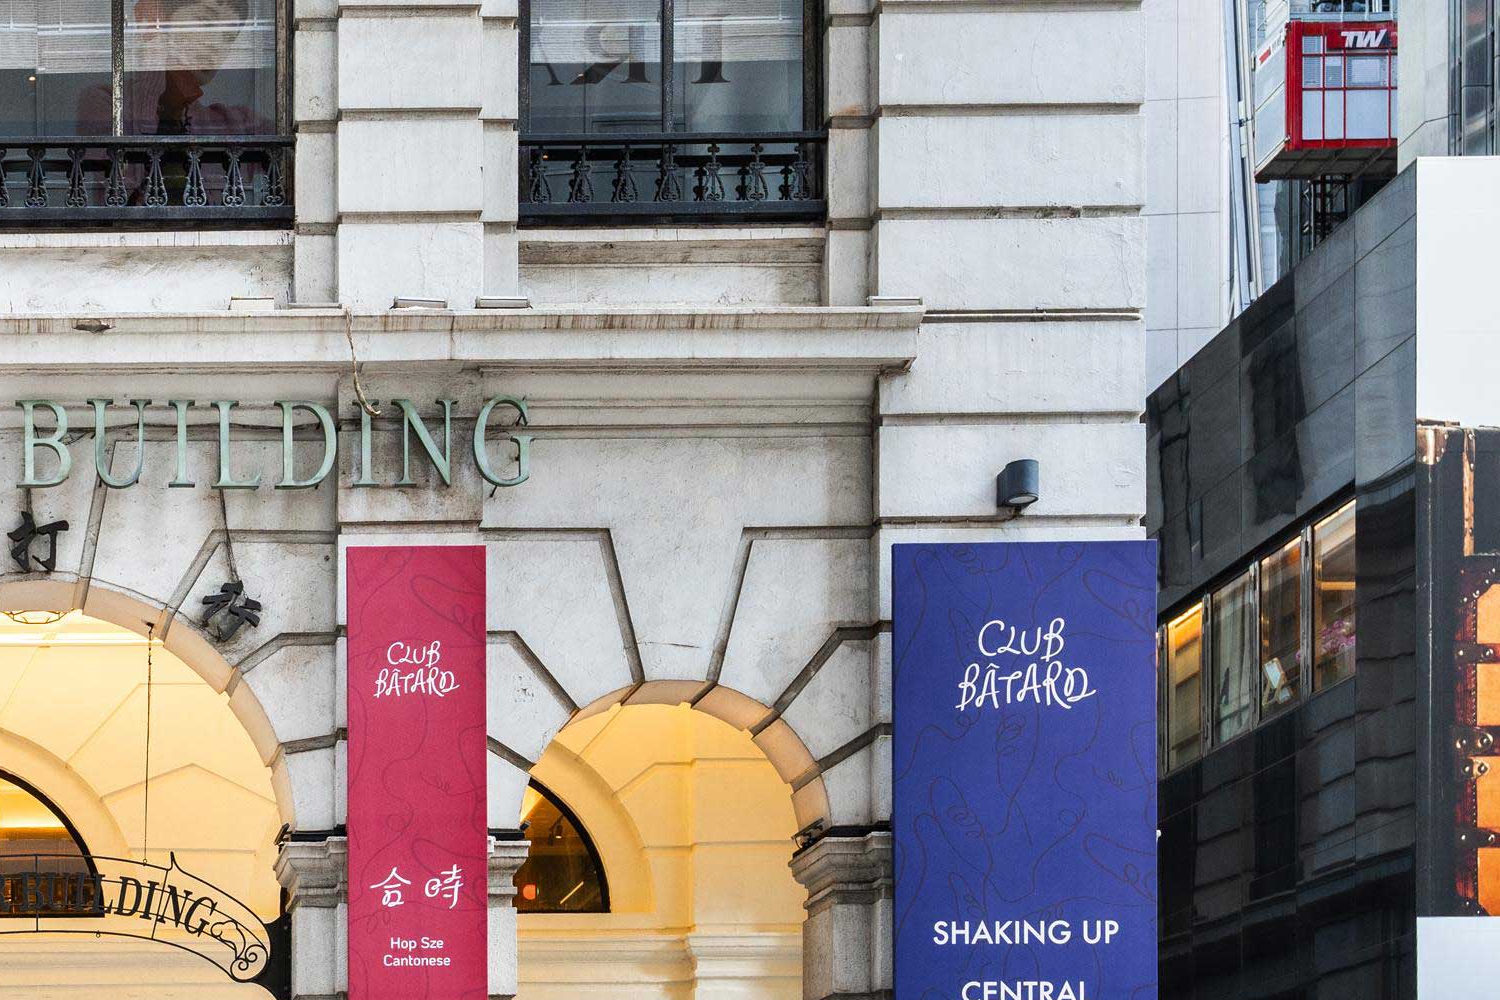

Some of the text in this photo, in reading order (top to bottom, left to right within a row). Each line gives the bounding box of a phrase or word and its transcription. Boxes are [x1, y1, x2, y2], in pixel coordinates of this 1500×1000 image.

[1340, 29, 1387, 48] TW
[15, 395, 532, 488] BUILDING
[386, 640, 441, 669] CLUB
[978, 617, 1066, 662] CLUB
[373, 666, 460, 699] BÂTARD
[956, 660, 1097, 711] BÂTARD
[20, 871, 218, 937] BUILDING
[390, 936, 444, 952] Hop Sze
[933, 919, 1119, 945] SHAKING UP
[383, 954, 451, 967] Cantonese
